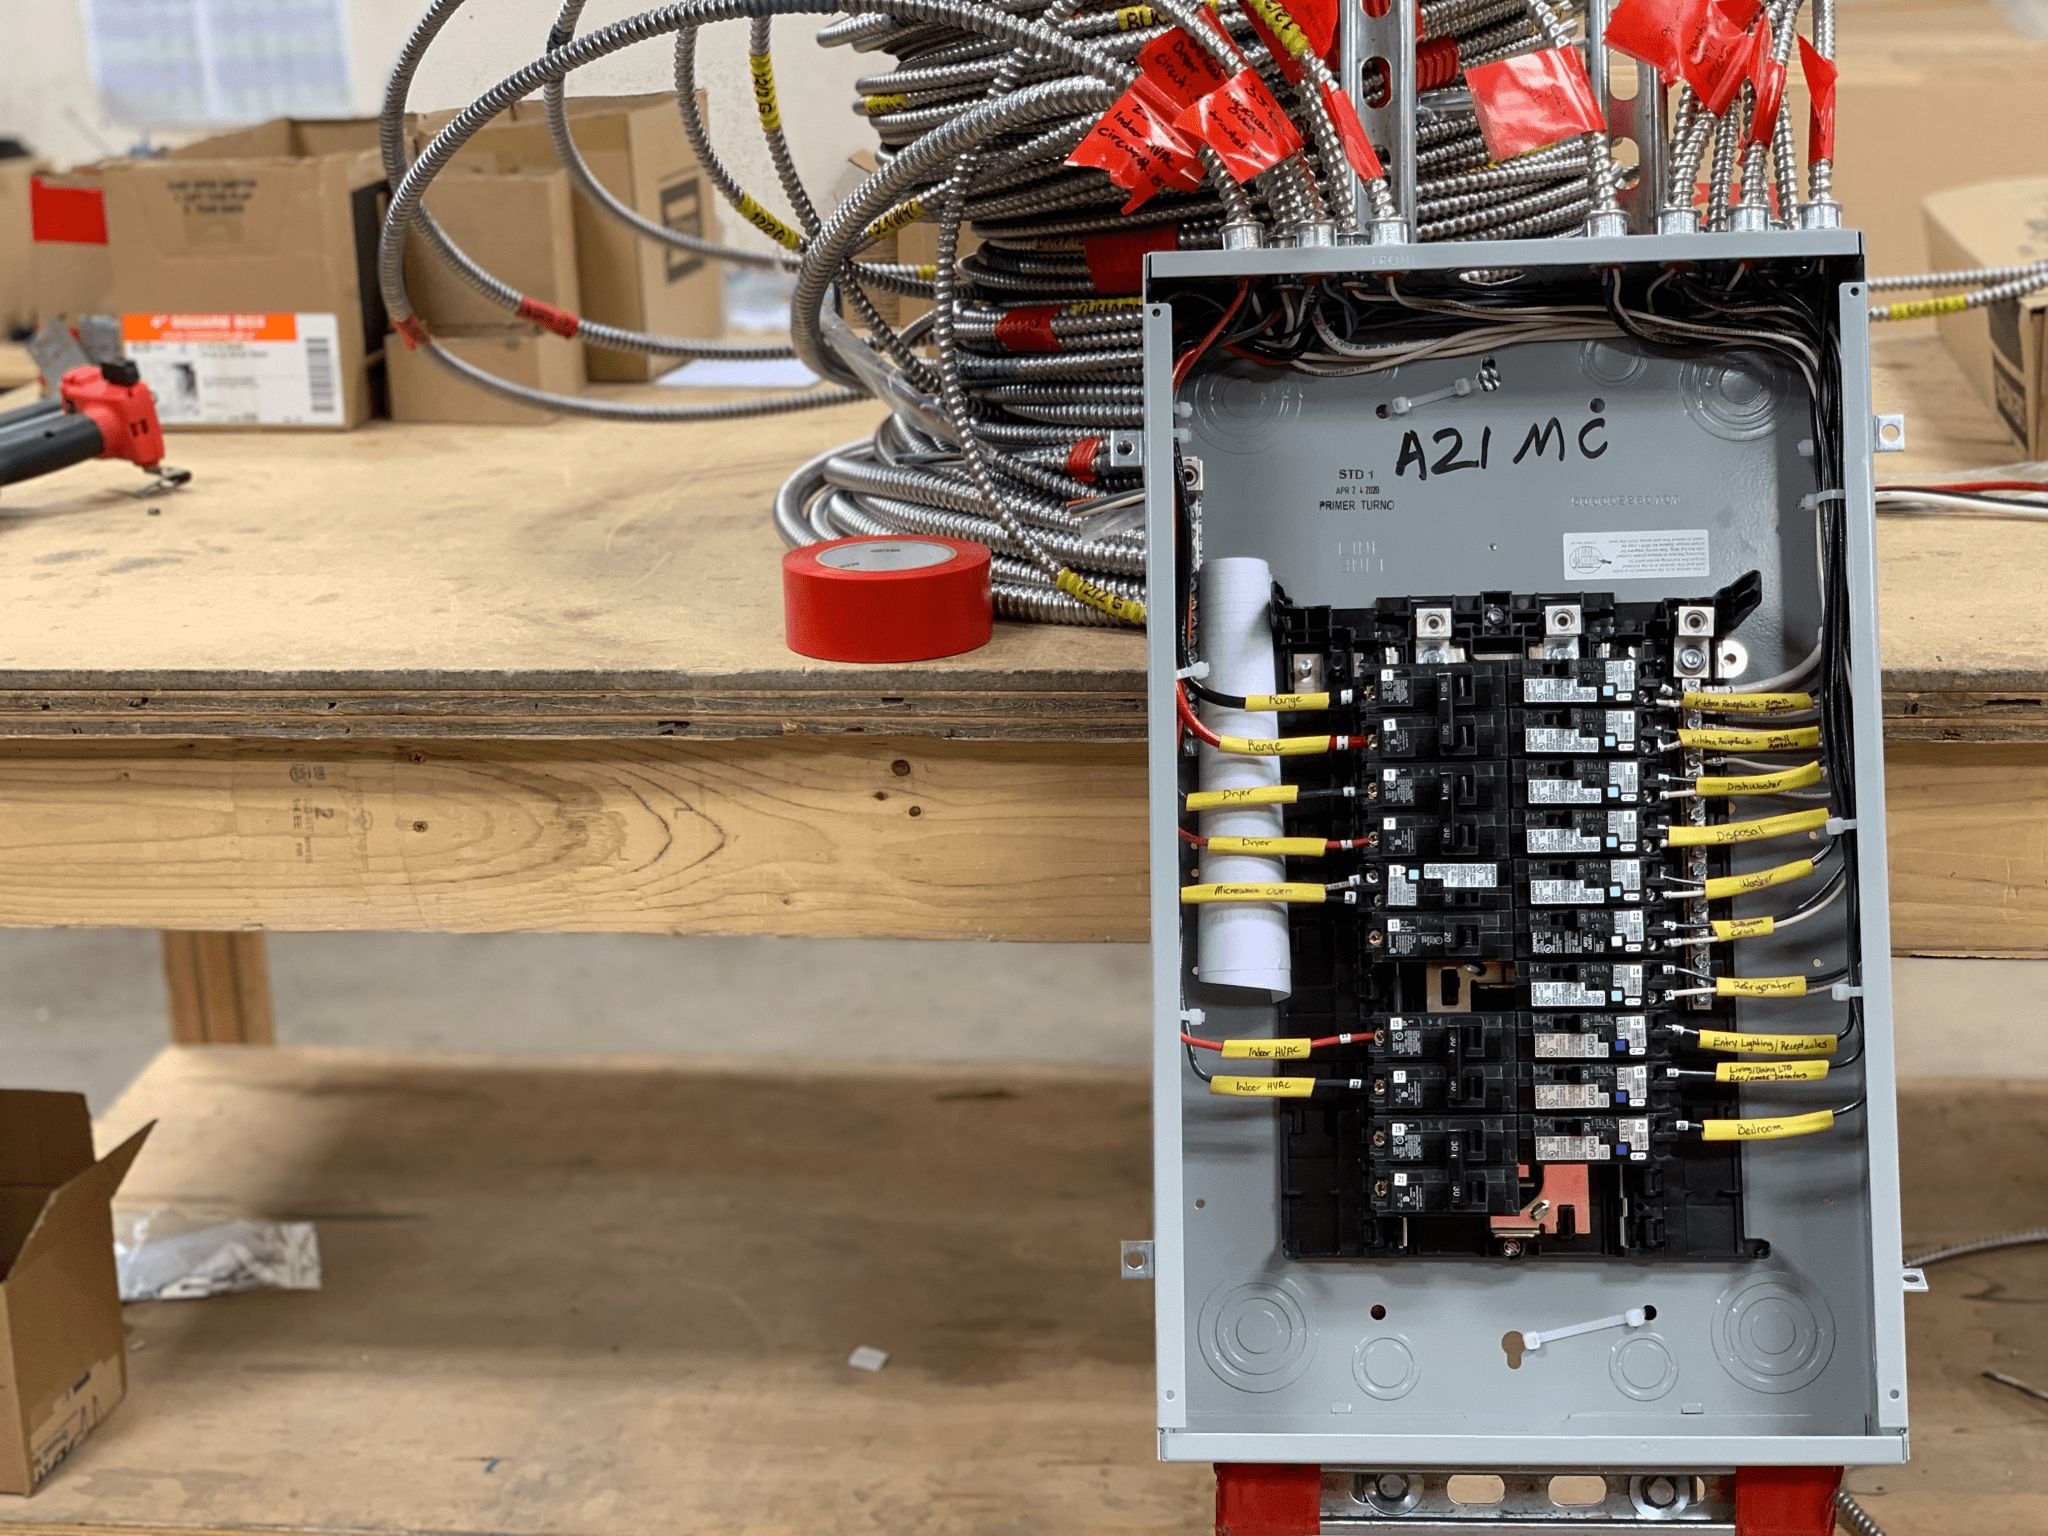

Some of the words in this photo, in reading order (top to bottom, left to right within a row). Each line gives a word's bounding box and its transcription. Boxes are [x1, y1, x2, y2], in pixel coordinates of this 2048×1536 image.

[1395, 426, 1491, 481] A21
[1338, 469, 1364, 480] STD
[1368, 470, 1374, 480] 1
[1335, 486, 1349, 495] APR
[1365, 486, 1380, 495] 2020
[1319, 500, 1356, 511] PRIMER
[1361, 500, 1395, 511] TURNO
[1269, 694, 1303, 709] Range
[1248, 739, 1284, 752] Range
[1223, 788, 1254, 800] Dryer
[1716, 825, 1765, 842] Disposal
[1242, 838, 1273, 848] Dryer
[1739, 874, 1774, 888] Washer
[1266, 887, 1293, 896] Oven
[1444, 932, 1452, 942] 20
[1632, 968, 1640, 976] 14
[1582, 1018, 1589, 1029] 20
[1274, 1046, 1300, 1057] HVAC
[1582, 1070, 1589, 1080] 20
[1236, 1081, 1262, 1091] Indoor
[1267, 1082, 1292, 1090] HVAC
[1583, 1122, 1590, 1132] 20
[1737, 1124, 1783, 1136] Bedroom
[1451, 1141, 1459, 1151] 30
[1453, 1186, 1460, 1197] 30
